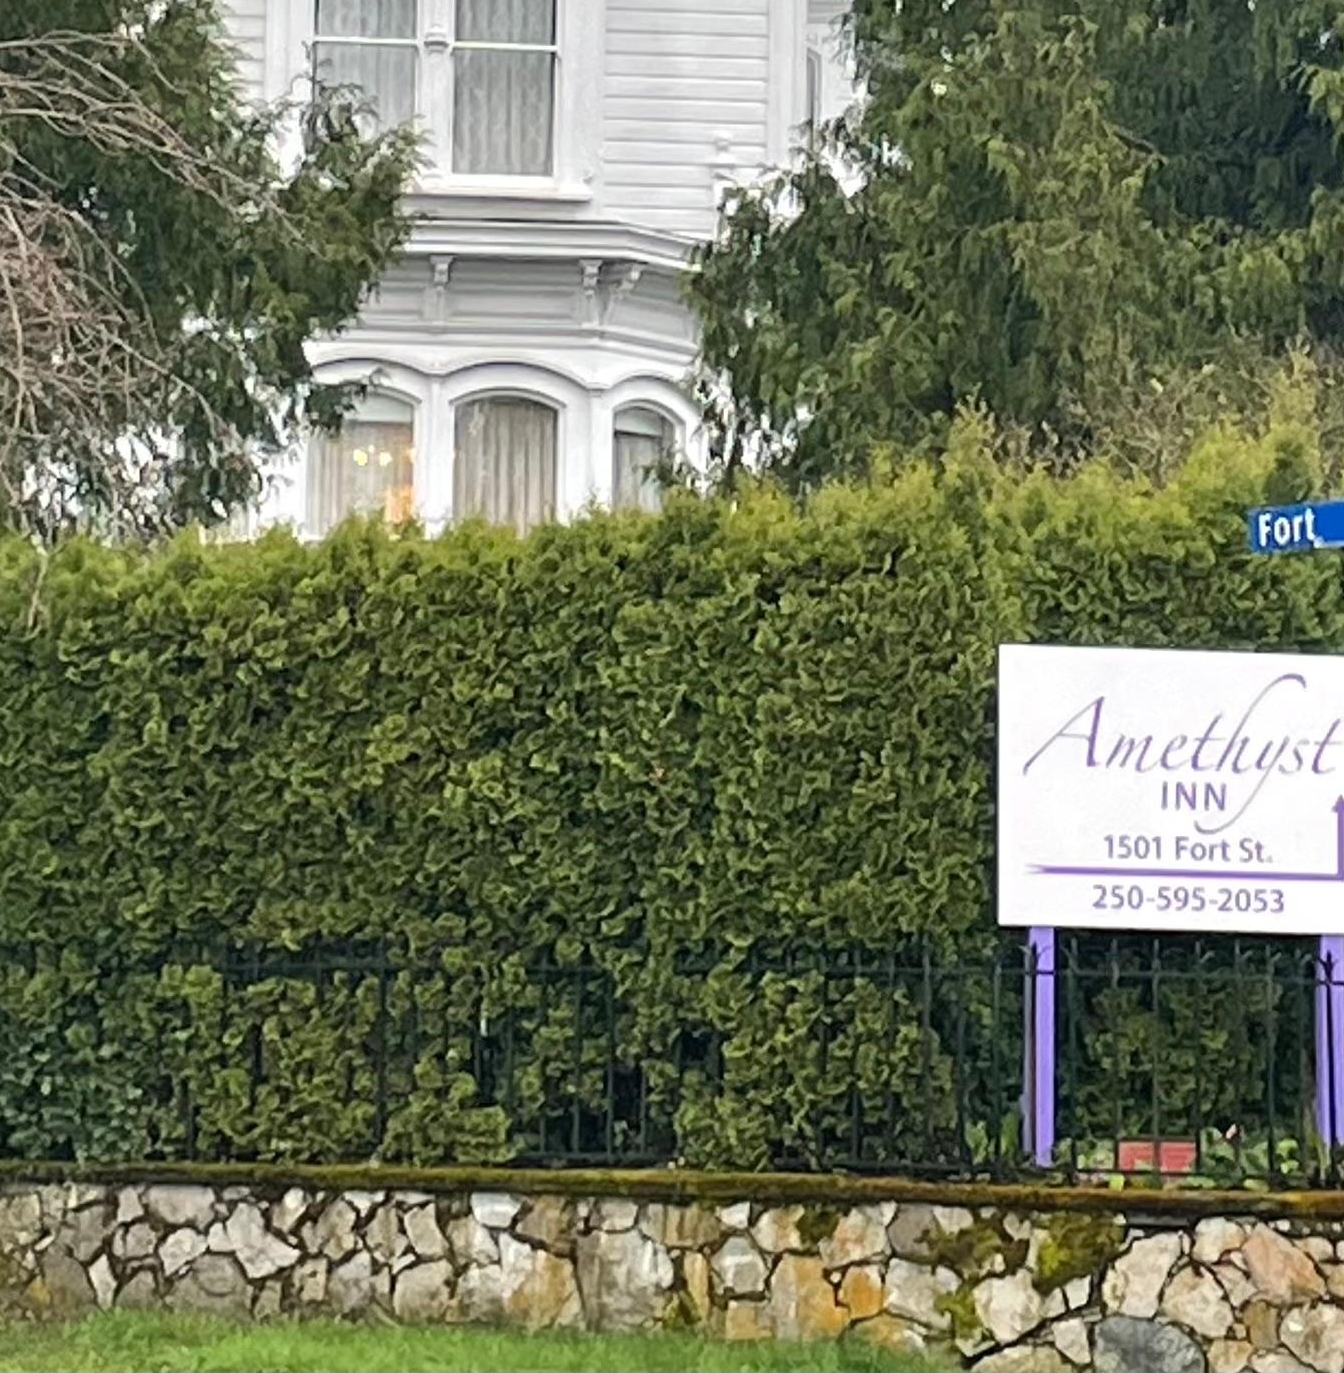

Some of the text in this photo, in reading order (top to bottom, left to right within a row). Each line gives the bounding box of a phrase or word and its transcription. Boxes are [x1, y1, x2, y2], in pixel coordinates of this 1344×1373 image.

[1258, 507, 1316, 547] Fort
[1023, 673, 1344, 835] Amethyst
[1160, 780, 1228, 812] INN
[1103, 834, 1274, 864] 1501 Fort St.
[1091, 883, 1286, 914] 250-595-2053
